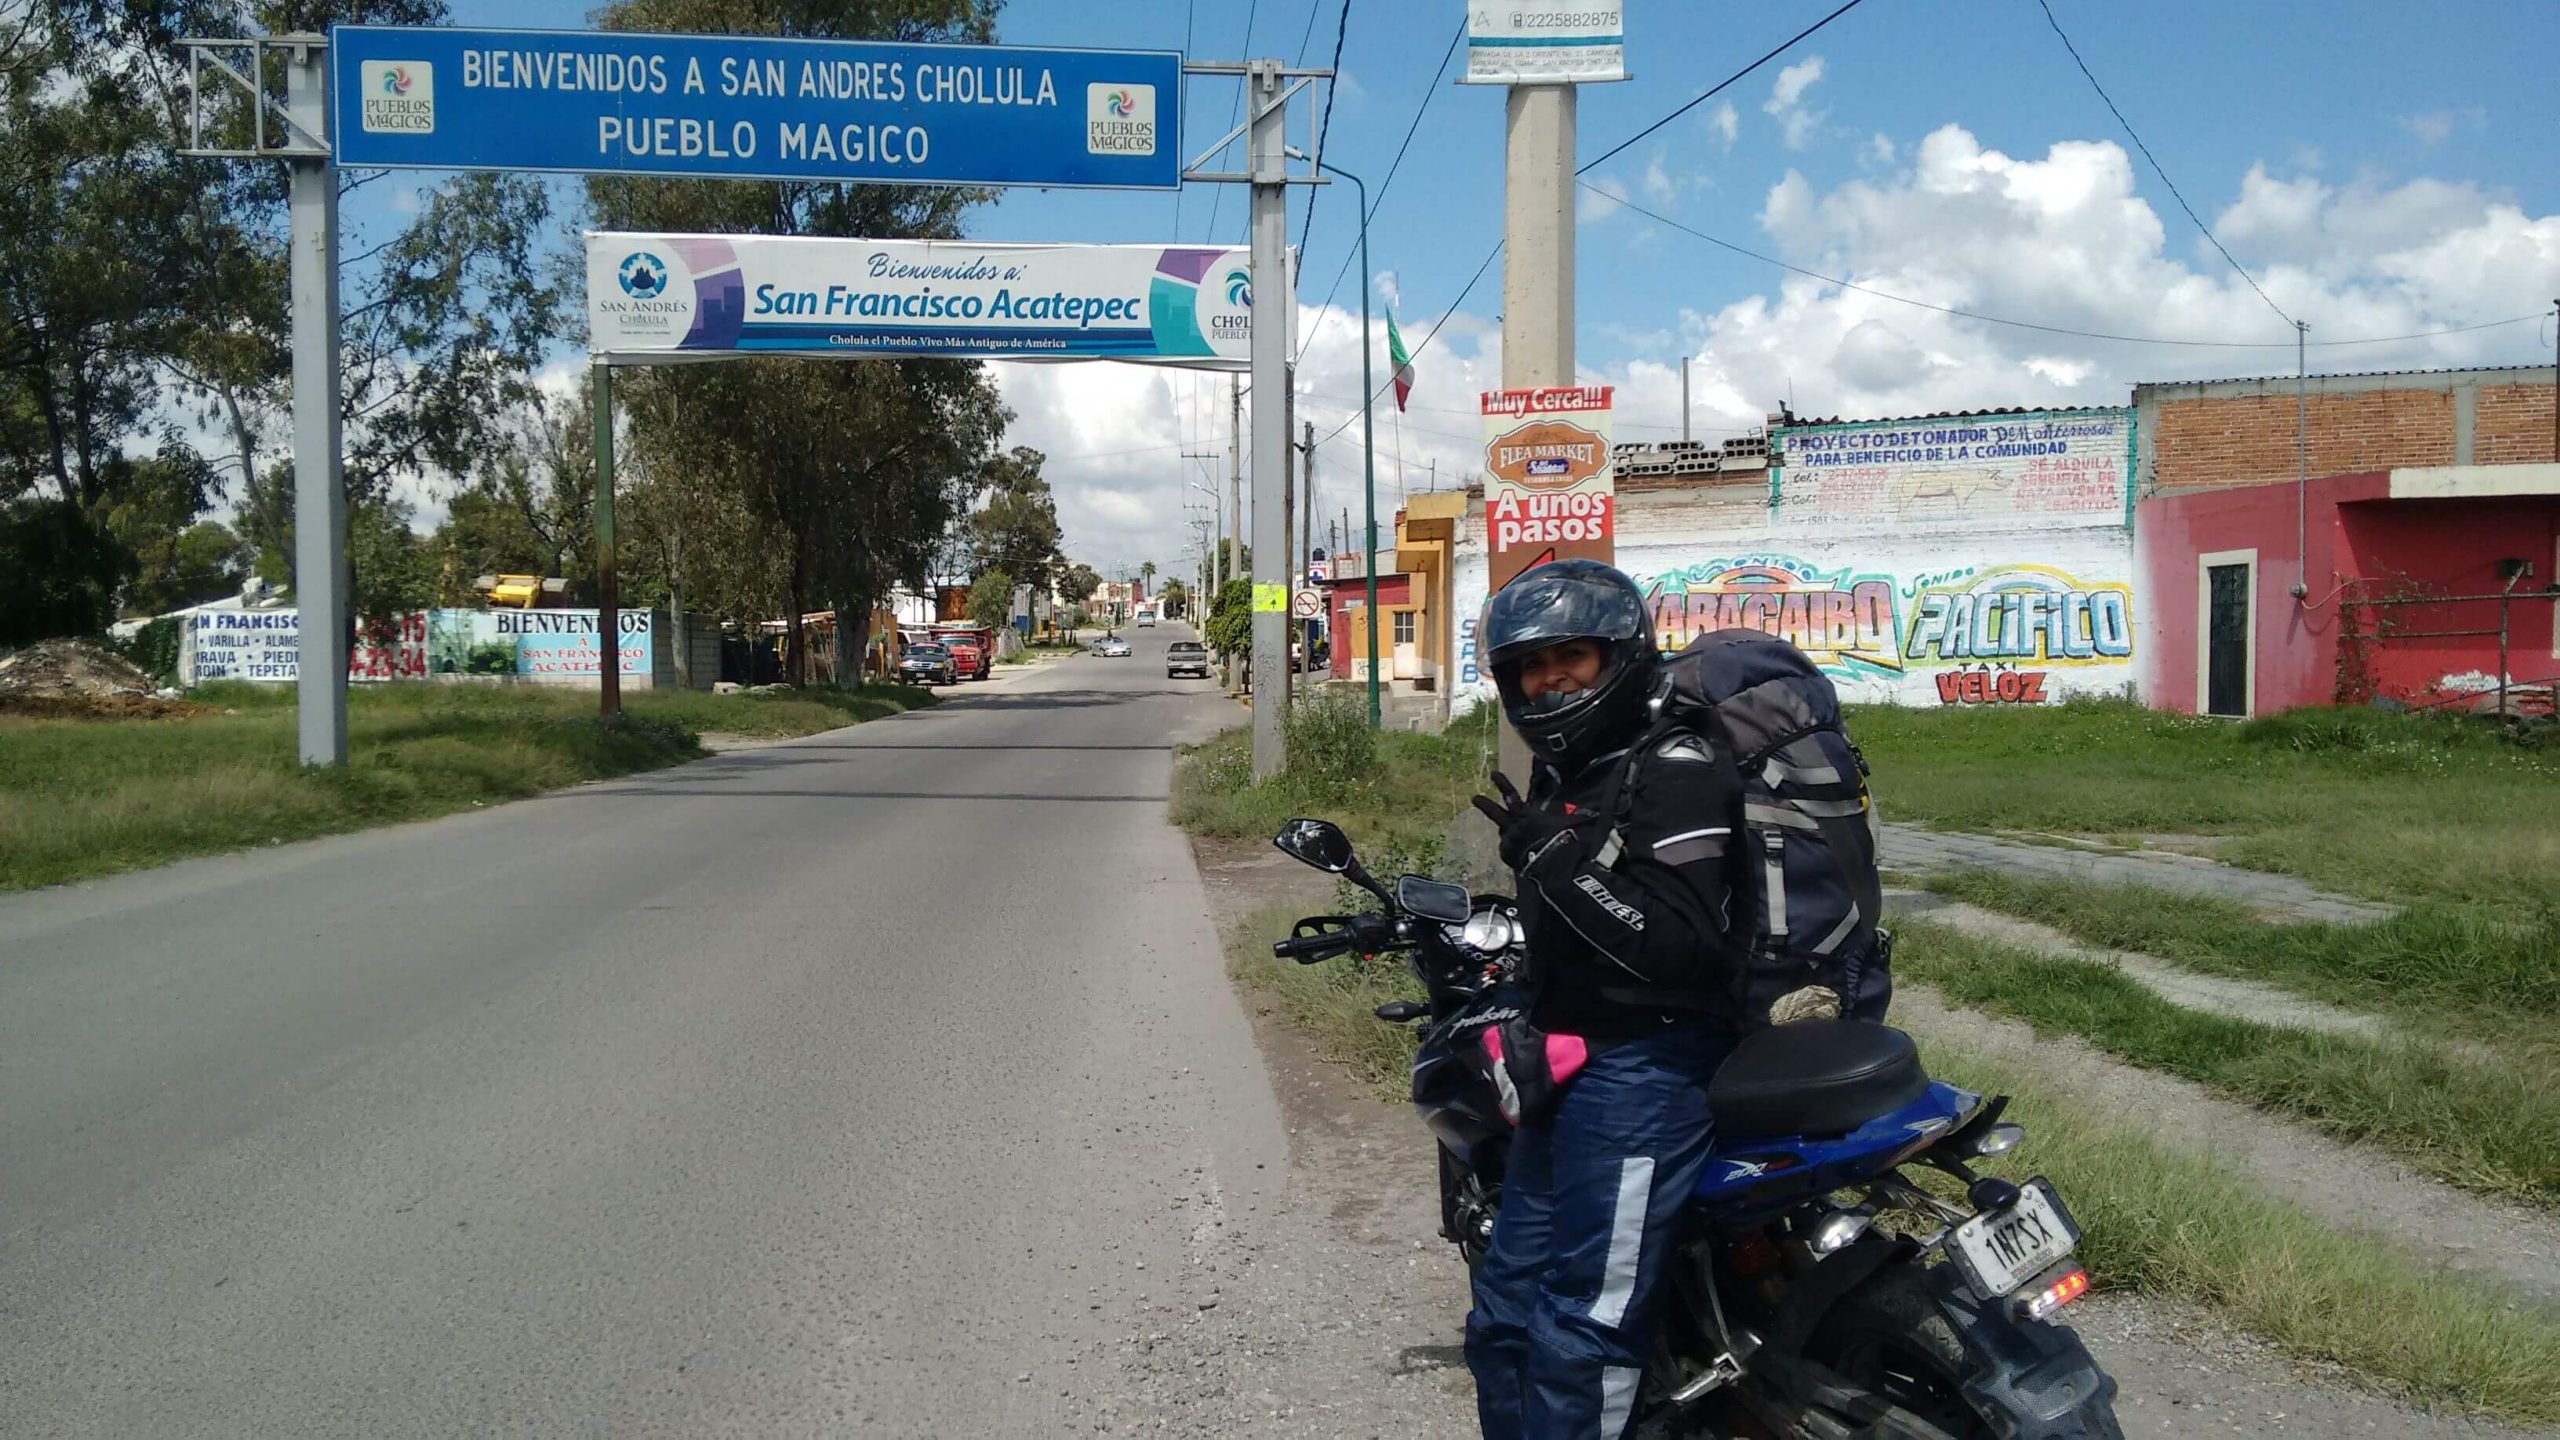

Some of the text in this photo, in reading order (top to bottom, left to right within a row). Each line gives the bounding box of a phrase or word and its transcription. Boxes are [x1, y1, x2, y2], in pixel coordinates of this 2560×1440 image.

[1527, 12, 1618, 28] 2225882875
[463, 49, 1057, 106] BIENVENIDOS A SAN ANDRES CHOLULA
[599, 115, 929, 164] PUEBLO MAGICO
[868, 252, 999, 281] Bienvenidos
[600, 301, 626, 312] SAN
[754, 284, 1141, 330] San Francisco Acatepec
[1212, 316, 1252, 328] CHOL
[829, 335, 1067, 350] Cholula el Pueblo Vivo Más Antiguo de América
[1487, 387, 1602, 419] Muy Cerca!!!
[1788, 434, 1885, 451] PROYECTO
[1888, 429, 1988, 447] DETONADOR
[1500, 446, 1532, 469] FLEA
[1535, 443, 1595, 465] MARKET
[1805, 441, 2067, 468] PARA BENEFICIO DE LA COMUNIDAD
[1494, 489, 1606, 519] A unos
[1497, 517, 1604, 552] pasos
[217, 615, 298, 630] FRANCISC
[1908, 590, 2133, 660] PACIFICO
[208, 635, 298, 648] VARILLA ALAME
[522, 649, 552, 660] SAN
[579, 638, 588, 647] A
[1958, 662, 2018, 673] TAXI
[1937, 673, 2048, 704] VELOZ
